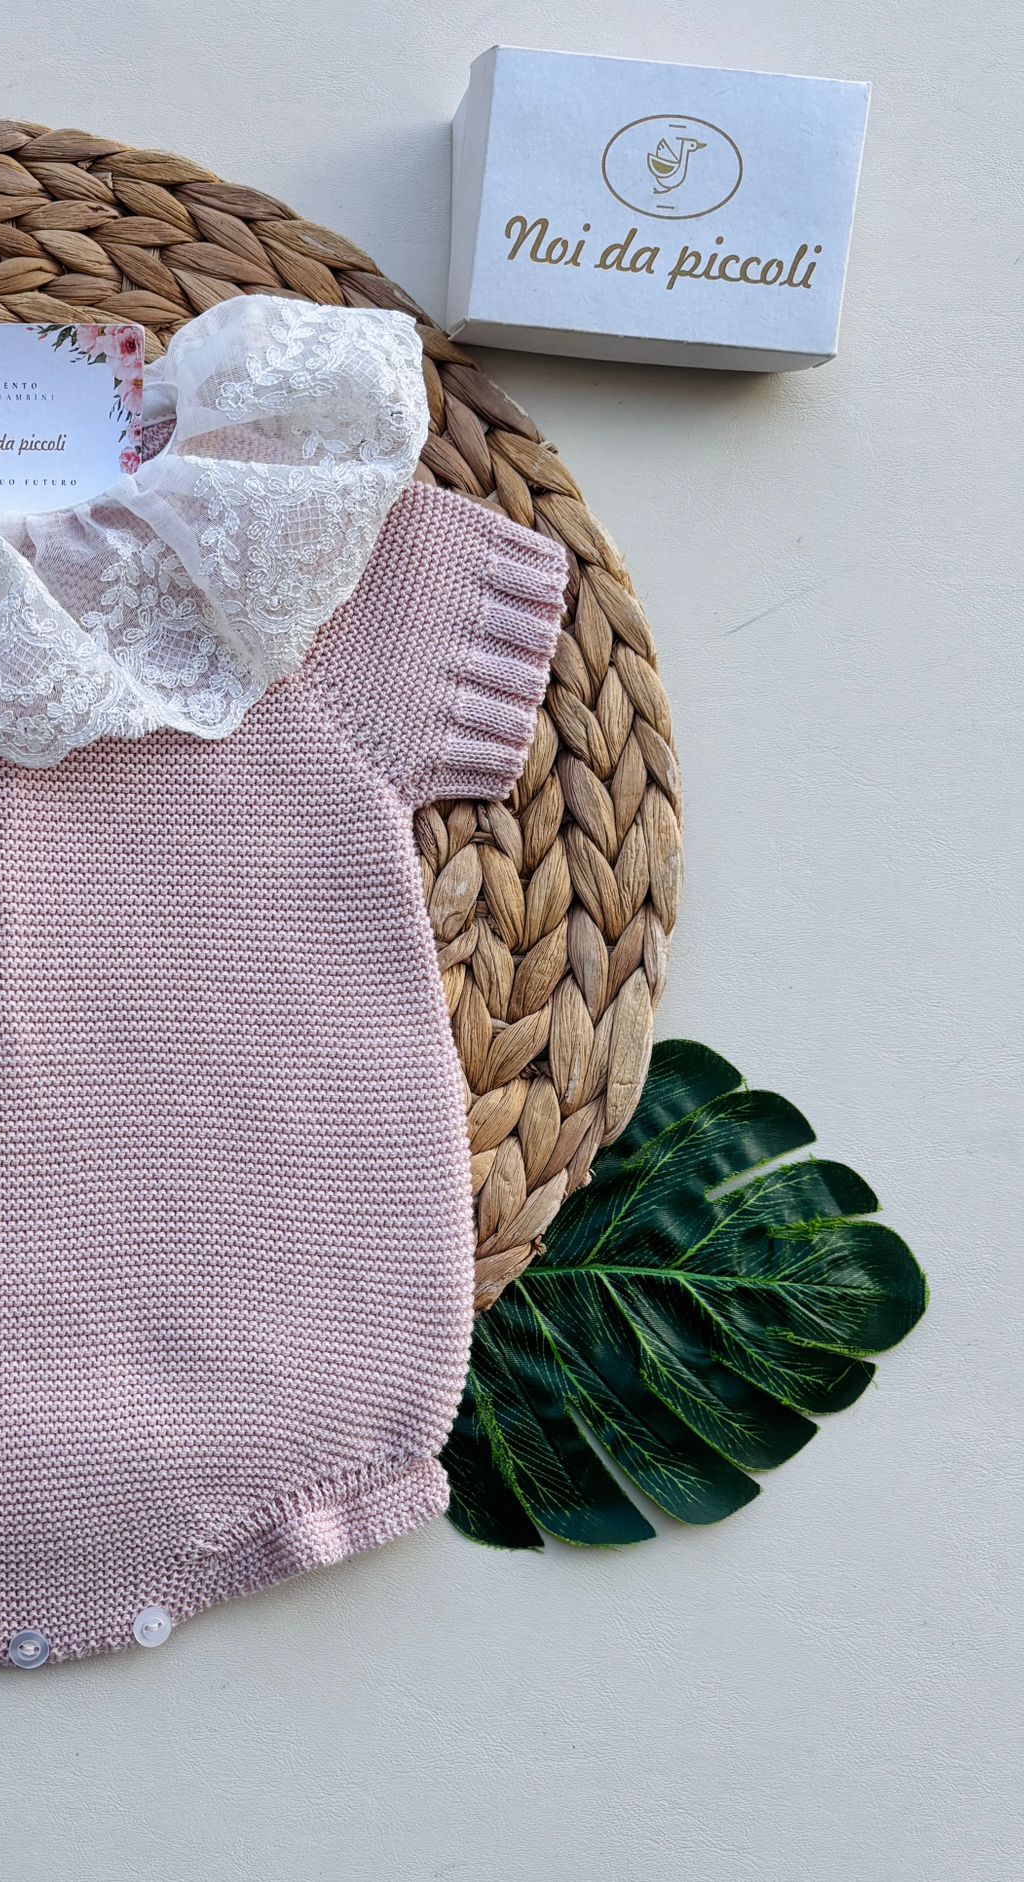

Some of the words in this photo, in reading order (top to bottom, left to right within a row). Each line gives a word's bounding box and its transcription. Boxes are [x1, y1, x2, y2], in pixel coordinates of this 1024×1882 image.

[504, 215, 592, 267] Noi
[594, 227, 660, 274] da
[666, 236, 823, 290] piccoli
[18, 434, 67, 455] piccoli
[25, 478, 78, 486] FUTURO
